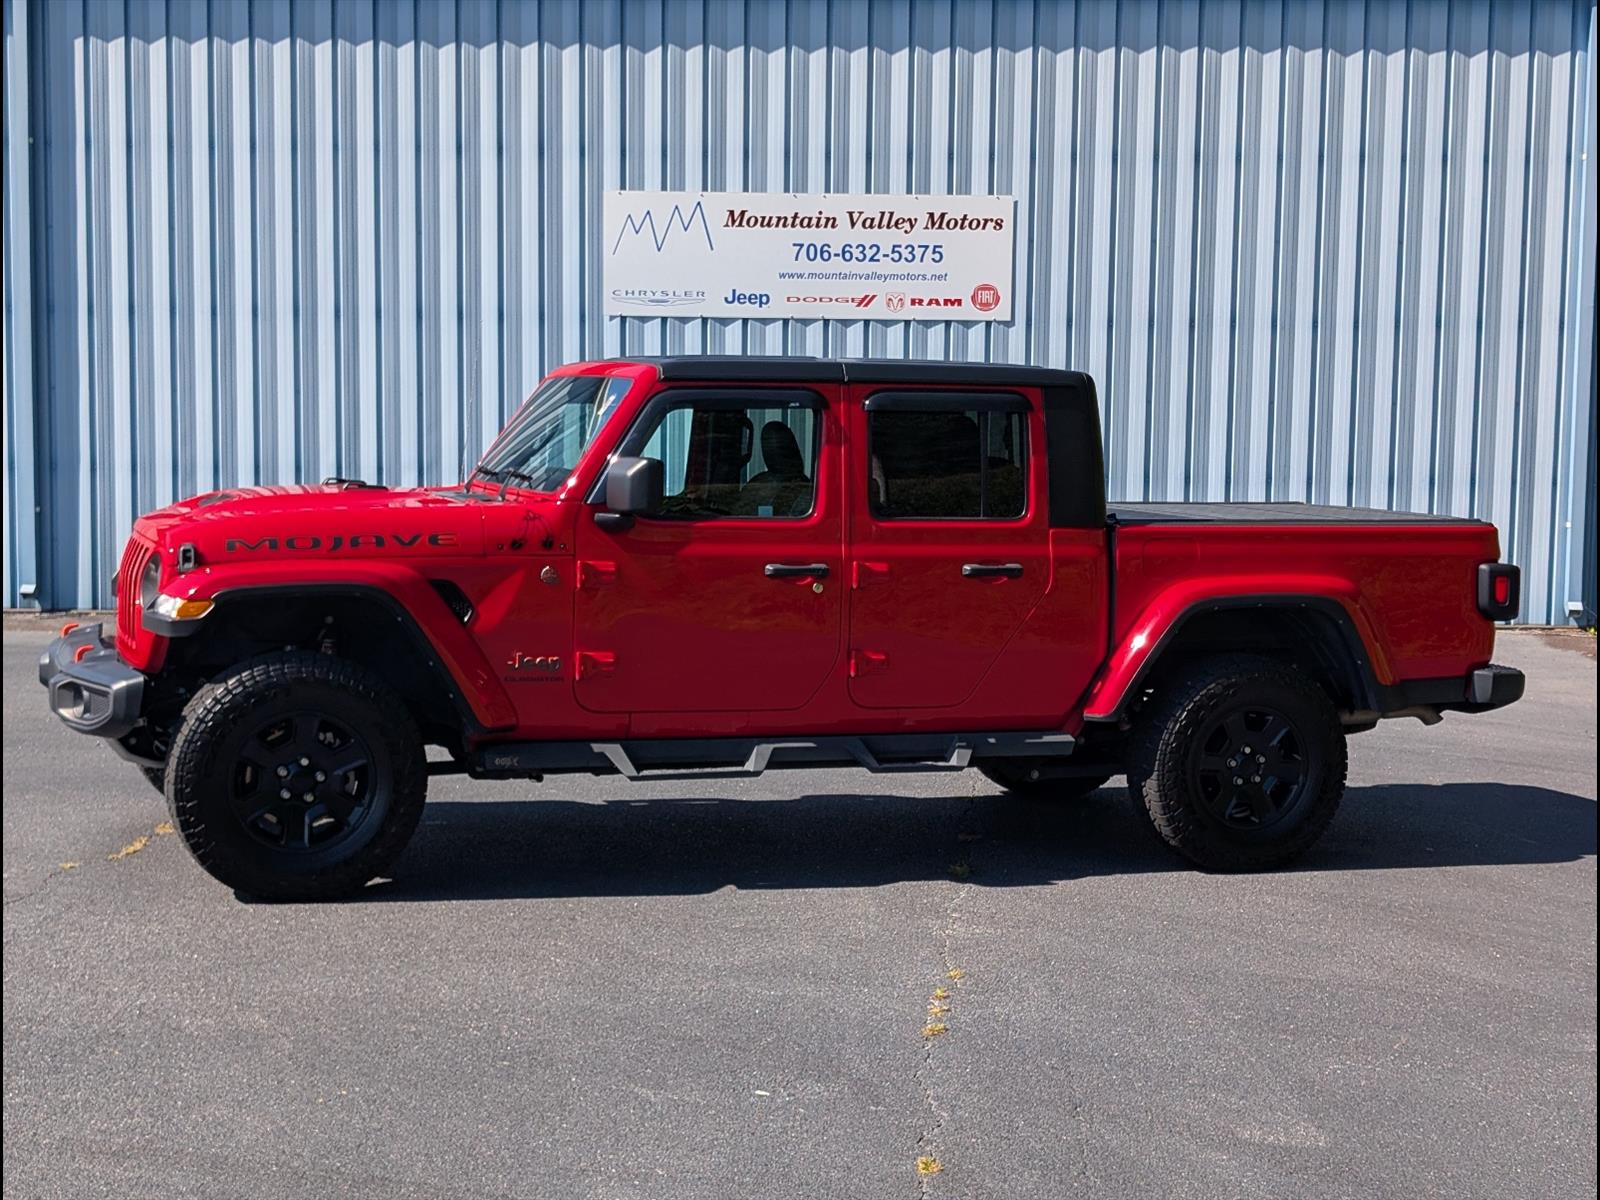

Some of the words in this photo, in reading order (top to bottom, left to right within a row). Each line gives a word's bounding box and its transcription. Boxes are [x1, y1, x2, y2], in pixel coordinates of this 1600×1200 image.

[723, 209, 839, 230] Mountain
[846, 211, 918, 234] Valley
[923, 212, 1005, 231] Motors
[792, 243, 945, 264] 706-632-5375
[778, 270, 949, 283] www.mountainvalleymotors.net
[612, 289, 706, 298] CHRYSLER
[724, 289, 770, 308] Jeep
[786, 296, 861, 304] DODGE
[977, 290, 994, 305] FIAT
[910, 298, 963, 307] RAM
[225, 533, 458, 553] MOJAVE
